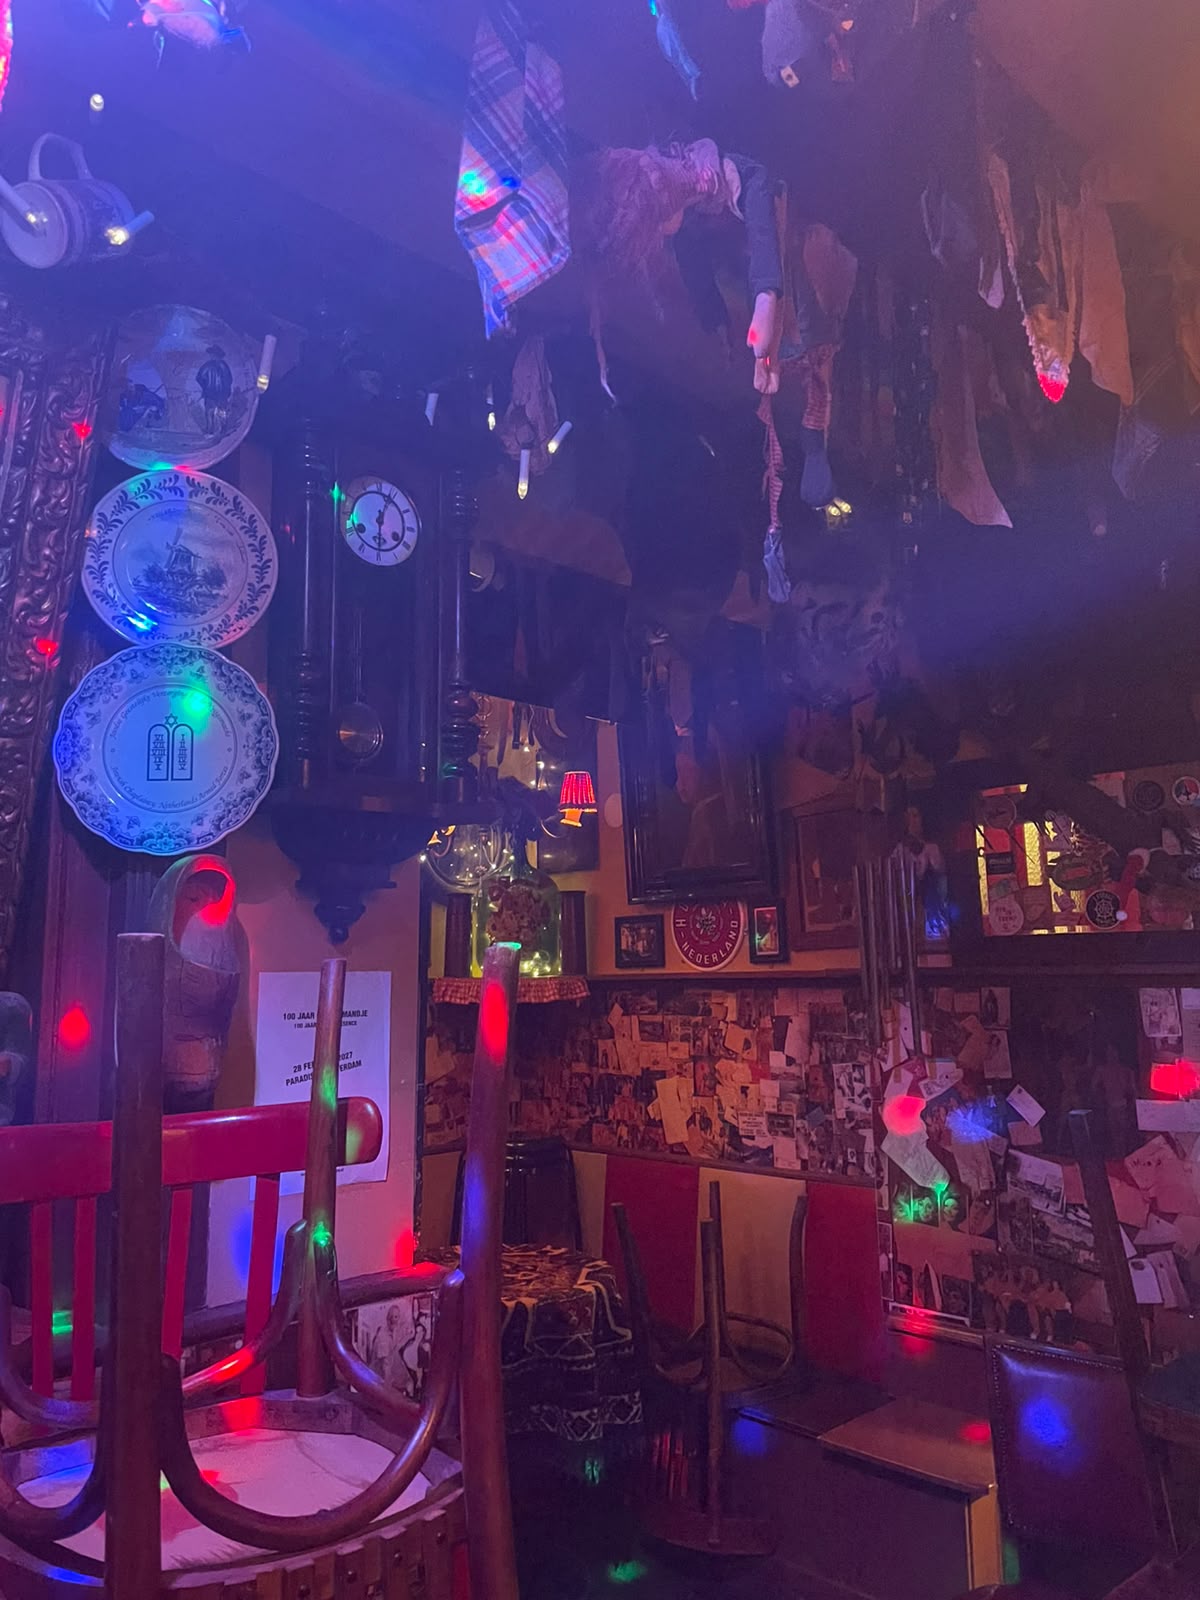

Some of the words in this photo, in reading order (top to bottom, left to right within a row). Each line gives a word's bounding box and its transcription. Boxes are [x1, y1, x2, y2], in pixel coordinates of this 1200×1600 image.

[681, 920, 739, 965] NEDERLAND
[283, 1012, 296, 1020] 100
[297, 1011, 315, 1020] JAAR
[285, 1072, 313, 1086] PARADI
[340, 1059, 362, 1072] ERDAM
[293, 1064, 302, 1073] 28
